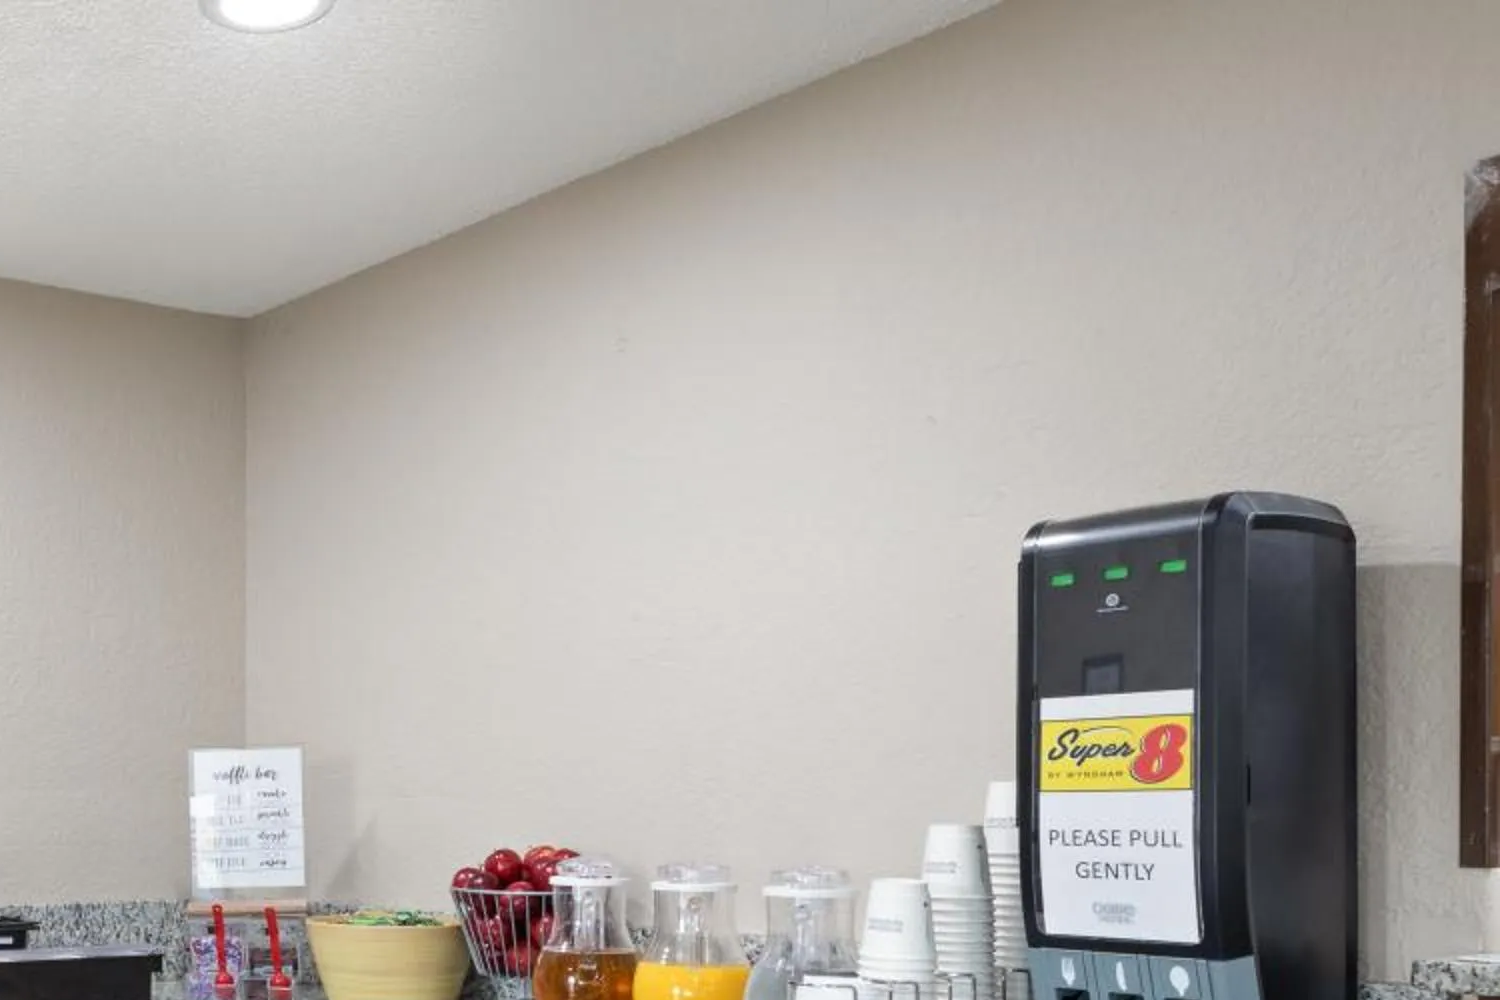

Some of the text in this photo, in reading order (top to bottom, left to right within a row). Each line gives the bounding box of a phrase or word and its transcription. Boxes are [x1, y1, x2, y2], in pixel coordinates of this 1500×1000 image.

[1048, 722, 1188, 785] Super 8
[1049, 829, 1183, 848] PLEASE PULL
[1075, 861, 1155, 881] GENTLY
